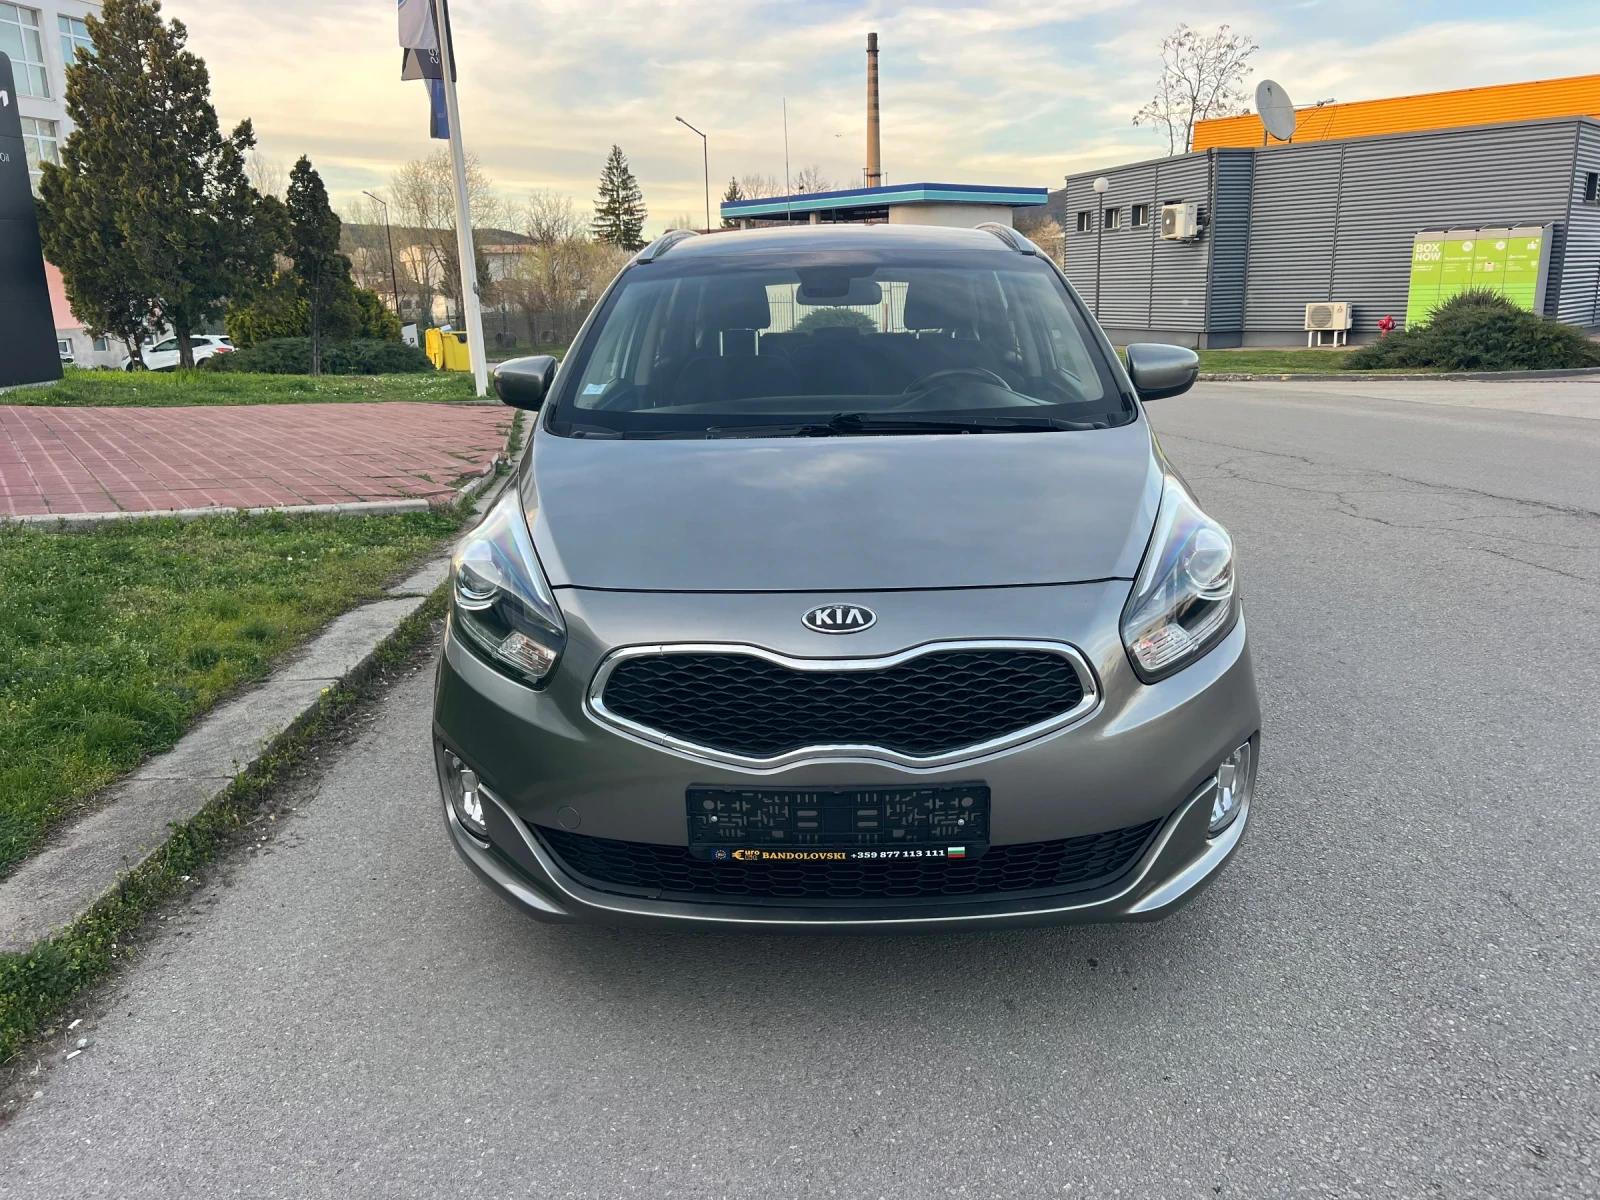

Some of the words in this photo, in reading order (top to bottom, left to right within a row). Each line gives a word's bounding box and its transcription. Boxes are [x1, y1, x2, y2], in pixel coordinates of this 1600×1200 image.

[1416, 243, 1440, 253] BOX
[1415, 252, 1441, 261] NOW
[815, 608, 865, 626] KIA
[762, 852, 846, 860] BANDOLOVSKI
[851, 851, 877, 859] +359
[903, 850, 922, 858] 113
